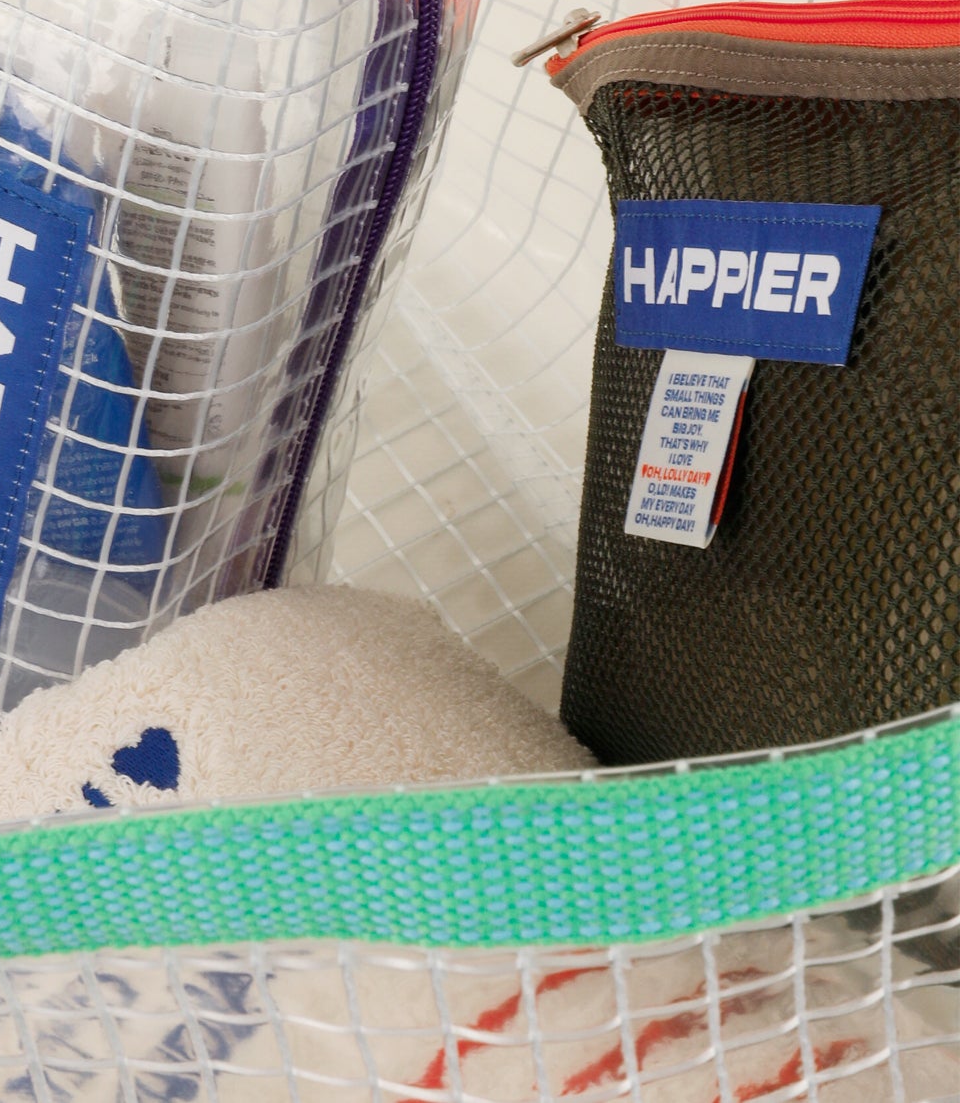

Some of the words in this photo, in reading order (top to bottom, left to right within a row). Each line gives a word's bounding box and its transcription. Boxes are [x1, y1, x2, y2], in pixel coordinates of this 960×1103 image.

[623, 247, 841, 316] HAPPIER
[672, 373, 708, 387] BELIEVE
[708, 375, 731, 389] THAT
[663, 388, 693, 403] SMALL
[694, 390, 726, 406] THINGS
[660, 405, 683, 419] CAN
[681, 406, 708, 421] BRING
[707, 409, 721, 423] ME
[672, 422, 688, 435] BIG
[660, 436, 690, 451] THAT'S
[689, 439, 709, 453] WHY
[671, 453, 694, 466] LOVE
[663, 468, 688, 481] LOLLY
[669, 485, 697, 500] MAKES
[640, 497, 656, 511] MY
[654, 498, 681, 513] EVERY
[678, 502, 696, 516] DAY
